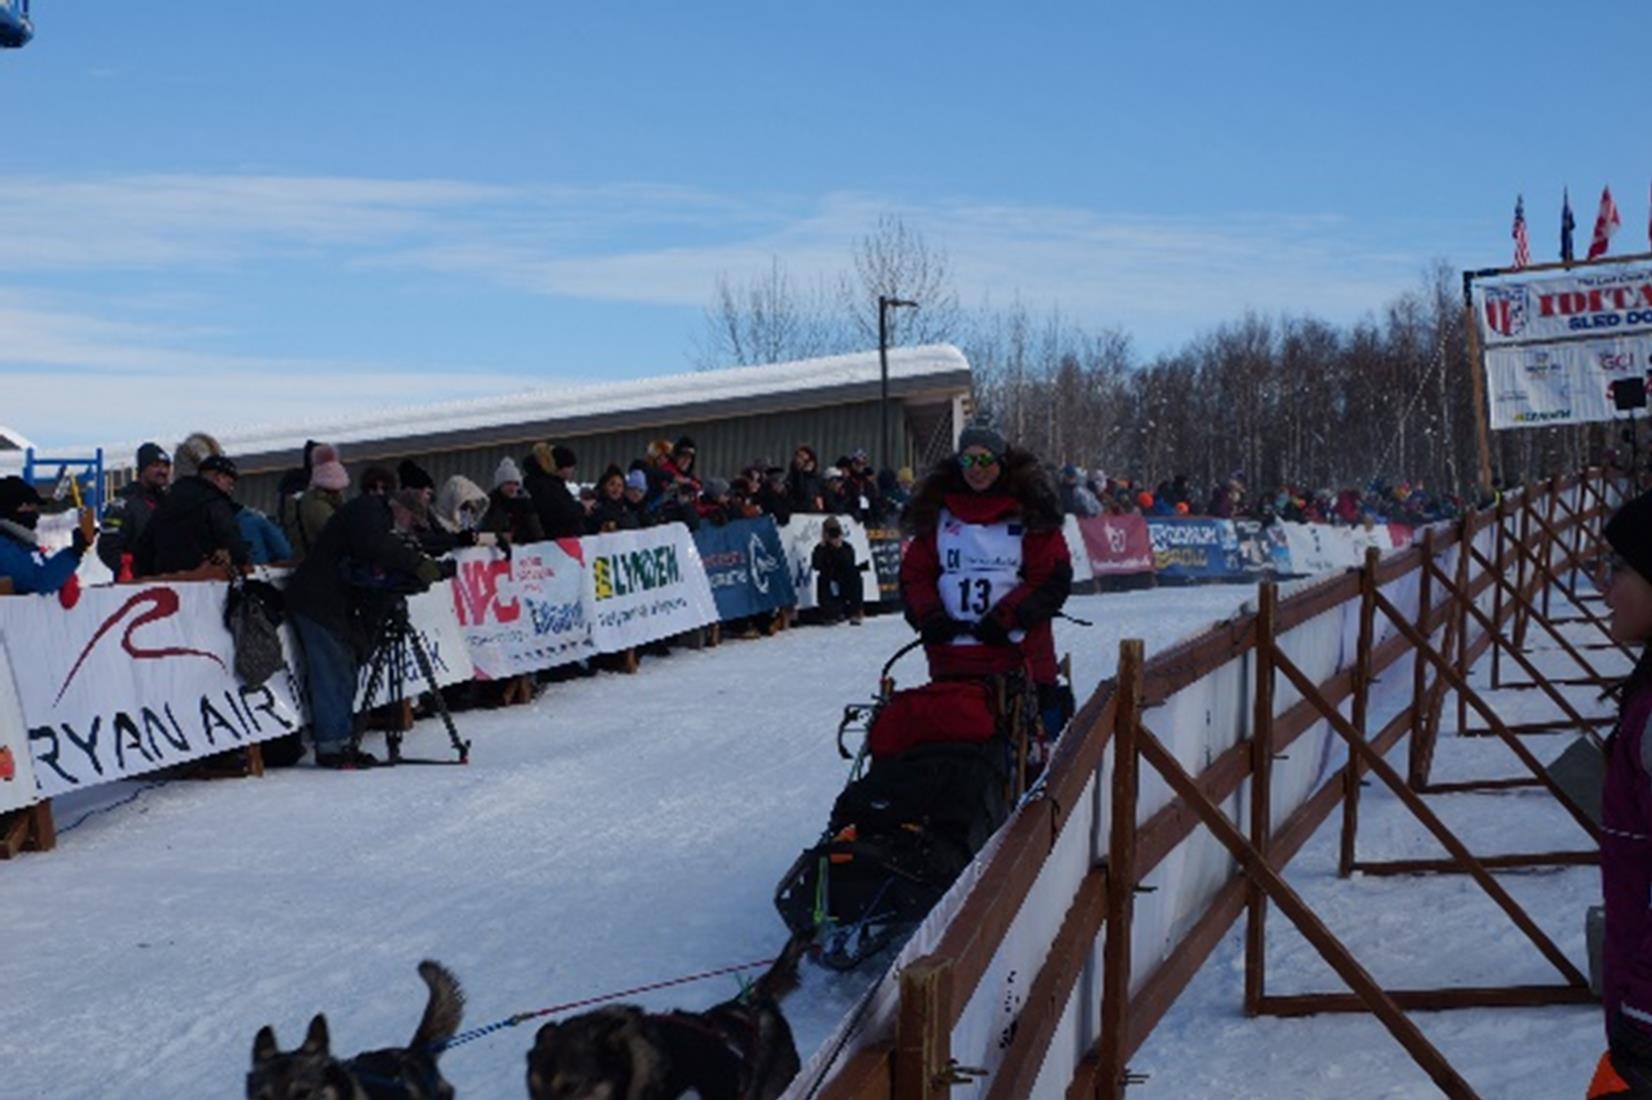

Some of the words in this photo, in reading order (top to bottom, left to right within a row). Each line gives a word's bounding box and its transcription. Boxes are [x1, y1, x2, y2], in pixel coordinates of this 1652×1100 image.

[1569, 313, 1620, 331] SLED
[612, 545, 679, 596] LYNDEN
[958, 578, 991, 614] 13
[28, 702, 191, 789] RYAN
[199, 686, 293, 746] AIR
